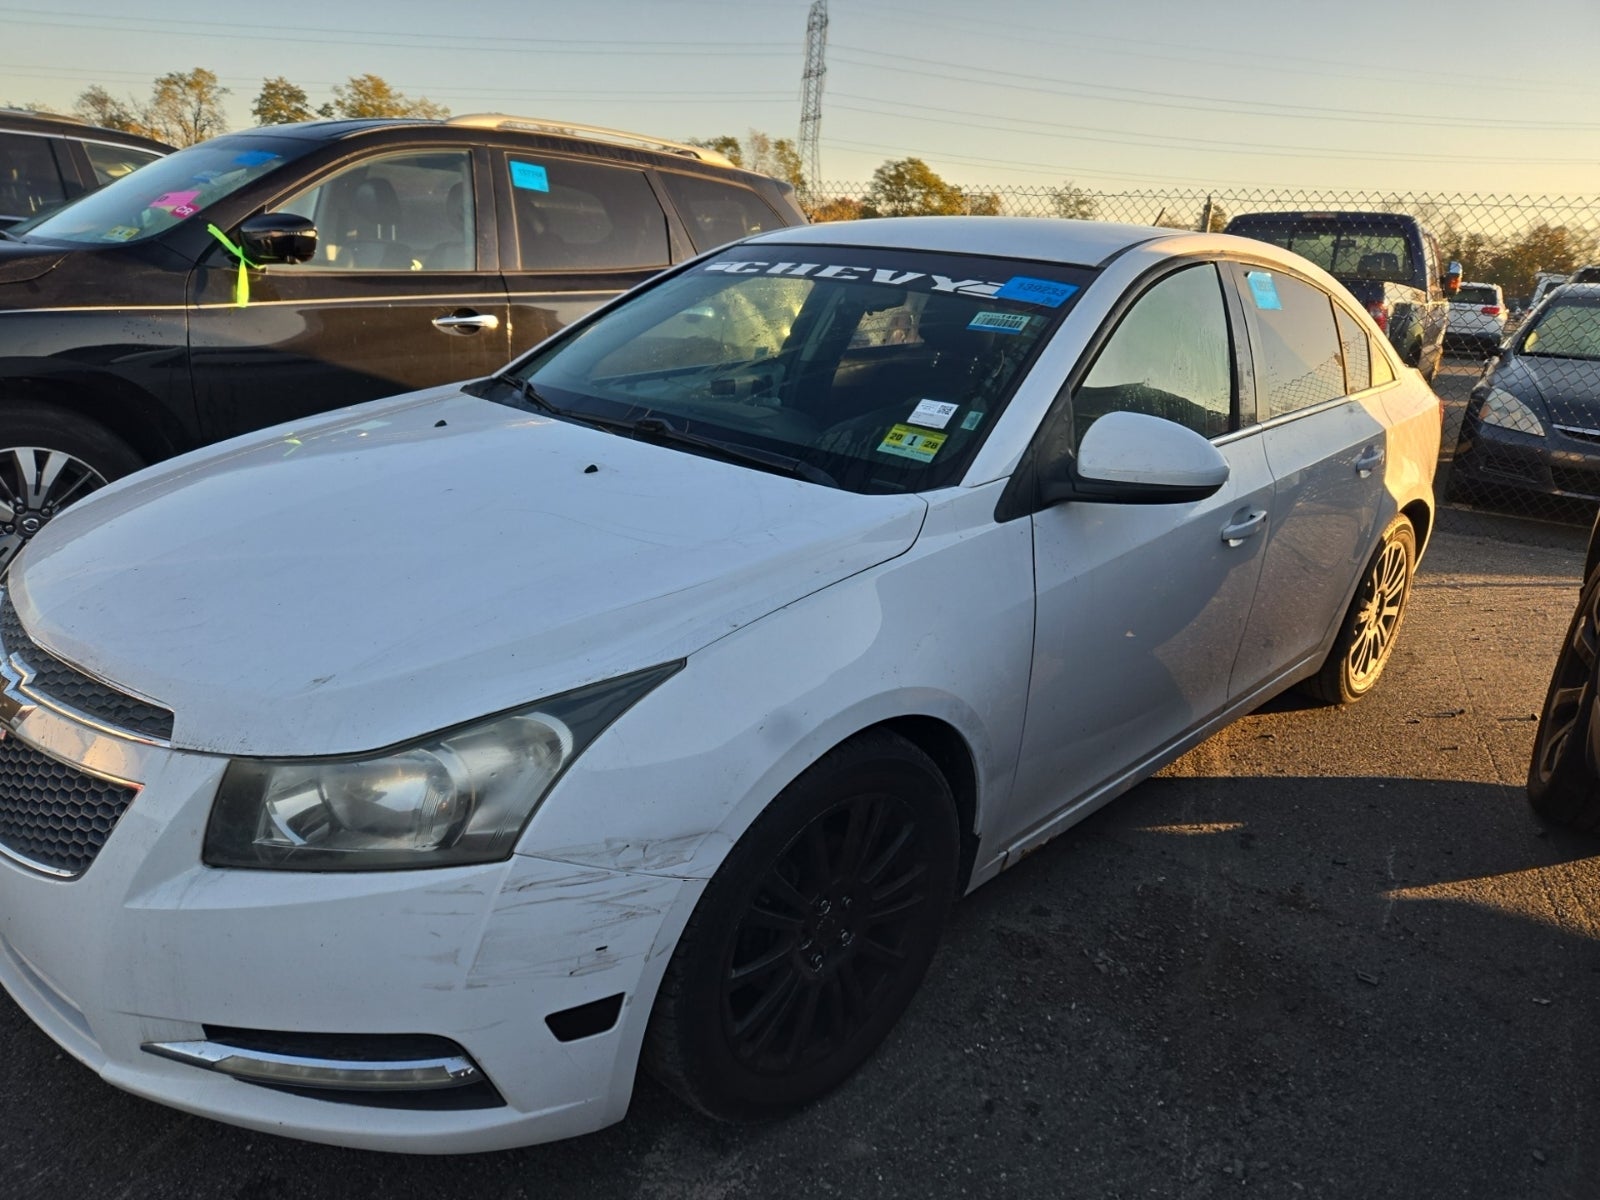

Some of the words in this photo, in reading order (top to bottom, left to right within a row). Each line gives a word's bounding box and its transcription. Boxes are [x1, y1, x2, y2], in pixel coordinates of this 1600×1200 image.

[175, 206, 194, 216] CR
[721, 261, 988, 293] CHEVY
[1017, 282, 1066, 297] 139233
[889, 432, 904, 441] 20
[907, 435, 918, 446] 1
[924, 440, 938, 449] 28
